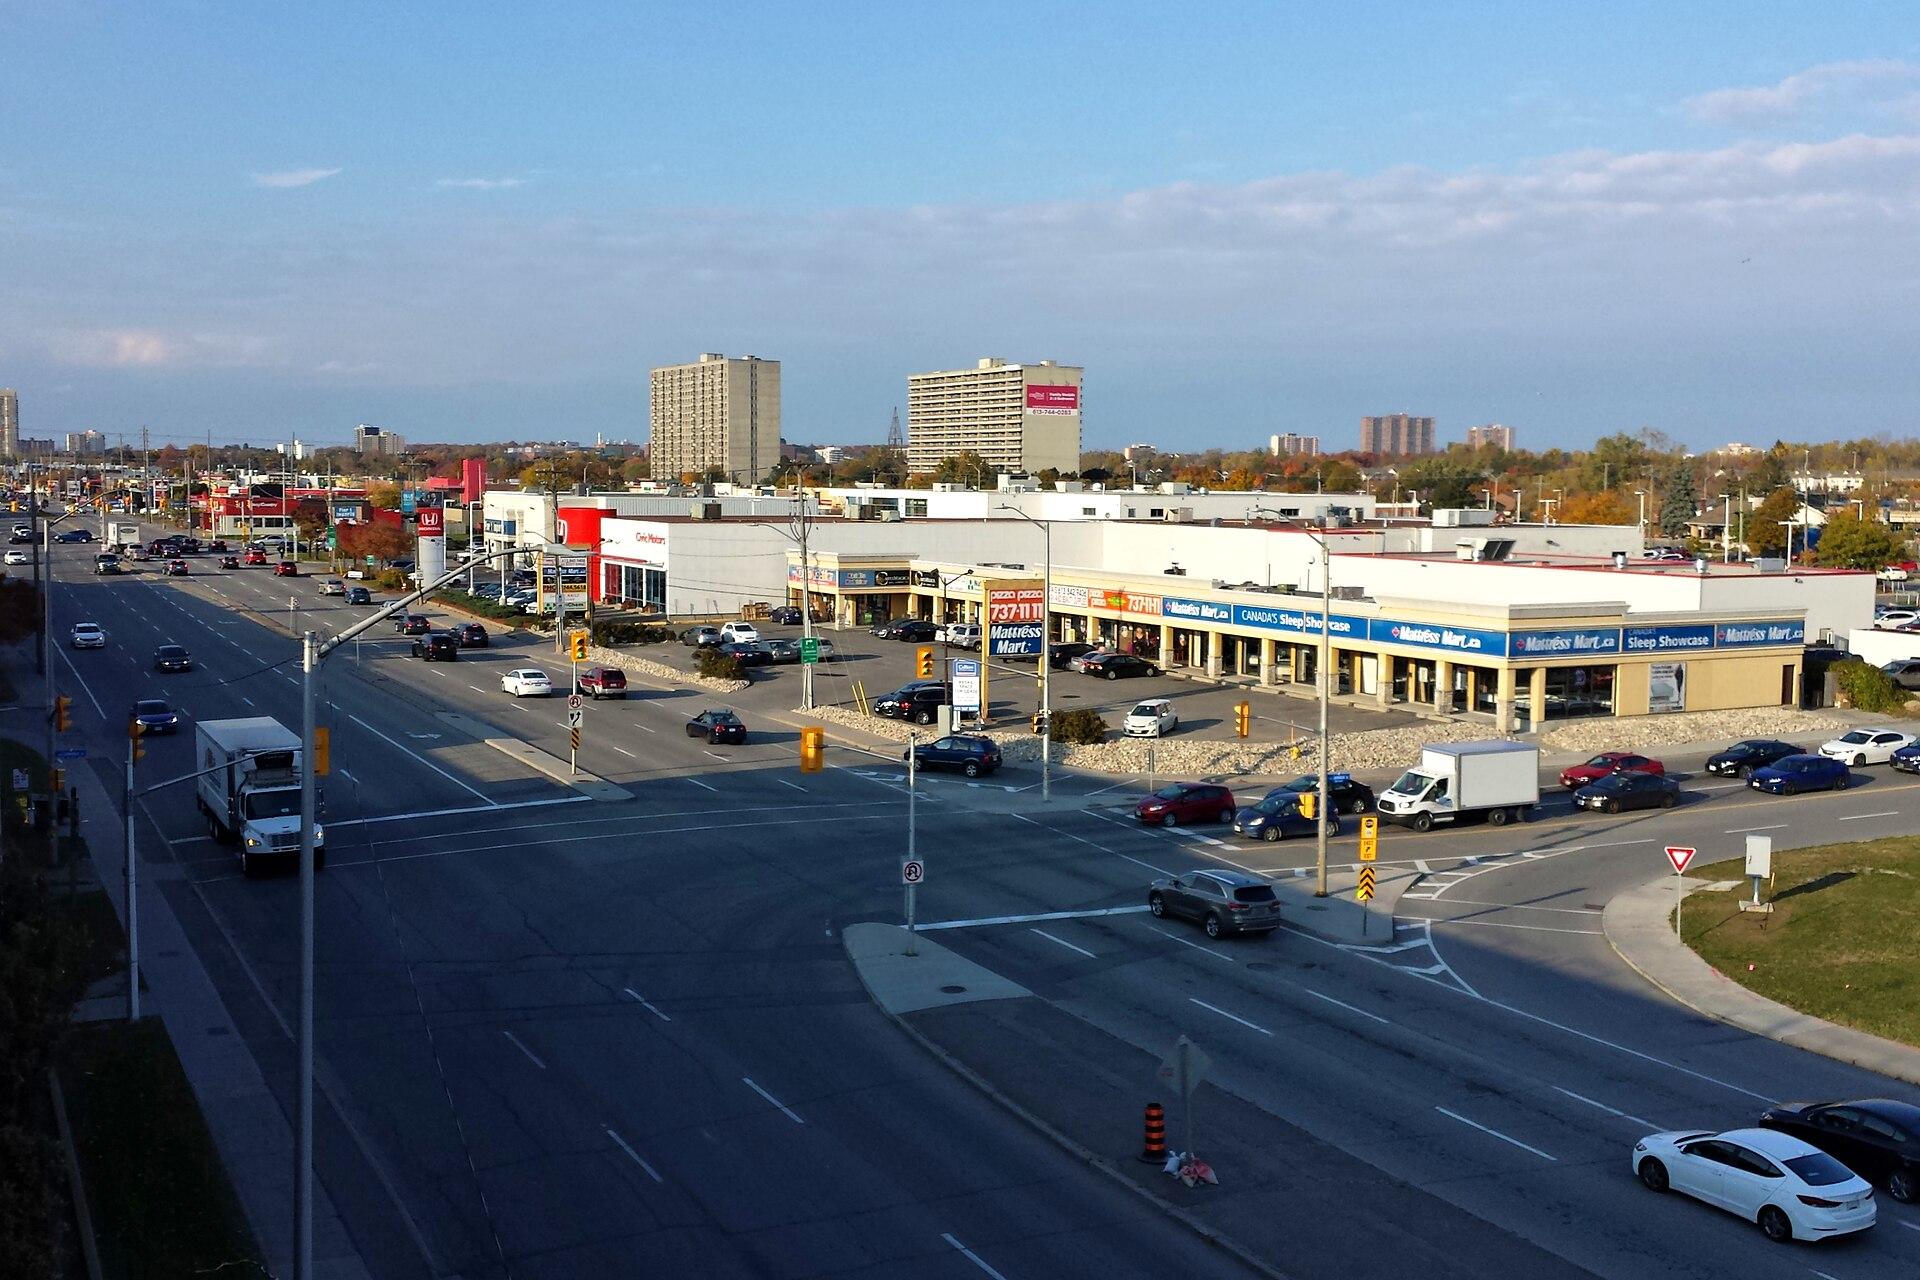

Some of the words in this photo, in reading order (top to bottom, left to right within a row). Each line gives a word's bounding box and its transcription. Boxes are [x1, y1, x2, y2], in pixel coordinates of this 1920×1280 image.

[991, 591, 1016, 601] pizza
[1017, 591, 1043, 602] pizza
[1170, 601, 1200, 616] Mattress
[1241, 609, 1278, 624] CANADA'S
[1279, 613, 1304, 629] Sleep
[991, 625, 1042, 639] Mattress
[1400, 625, 1440, 644] Mattress
[1724, 627, 1767, 642] Mattress
[1525, 635, 1571, 651] Mattress
[1627, 636, 1657, 650] Sleep
[1658, 635, 1709, 648] Showcase
